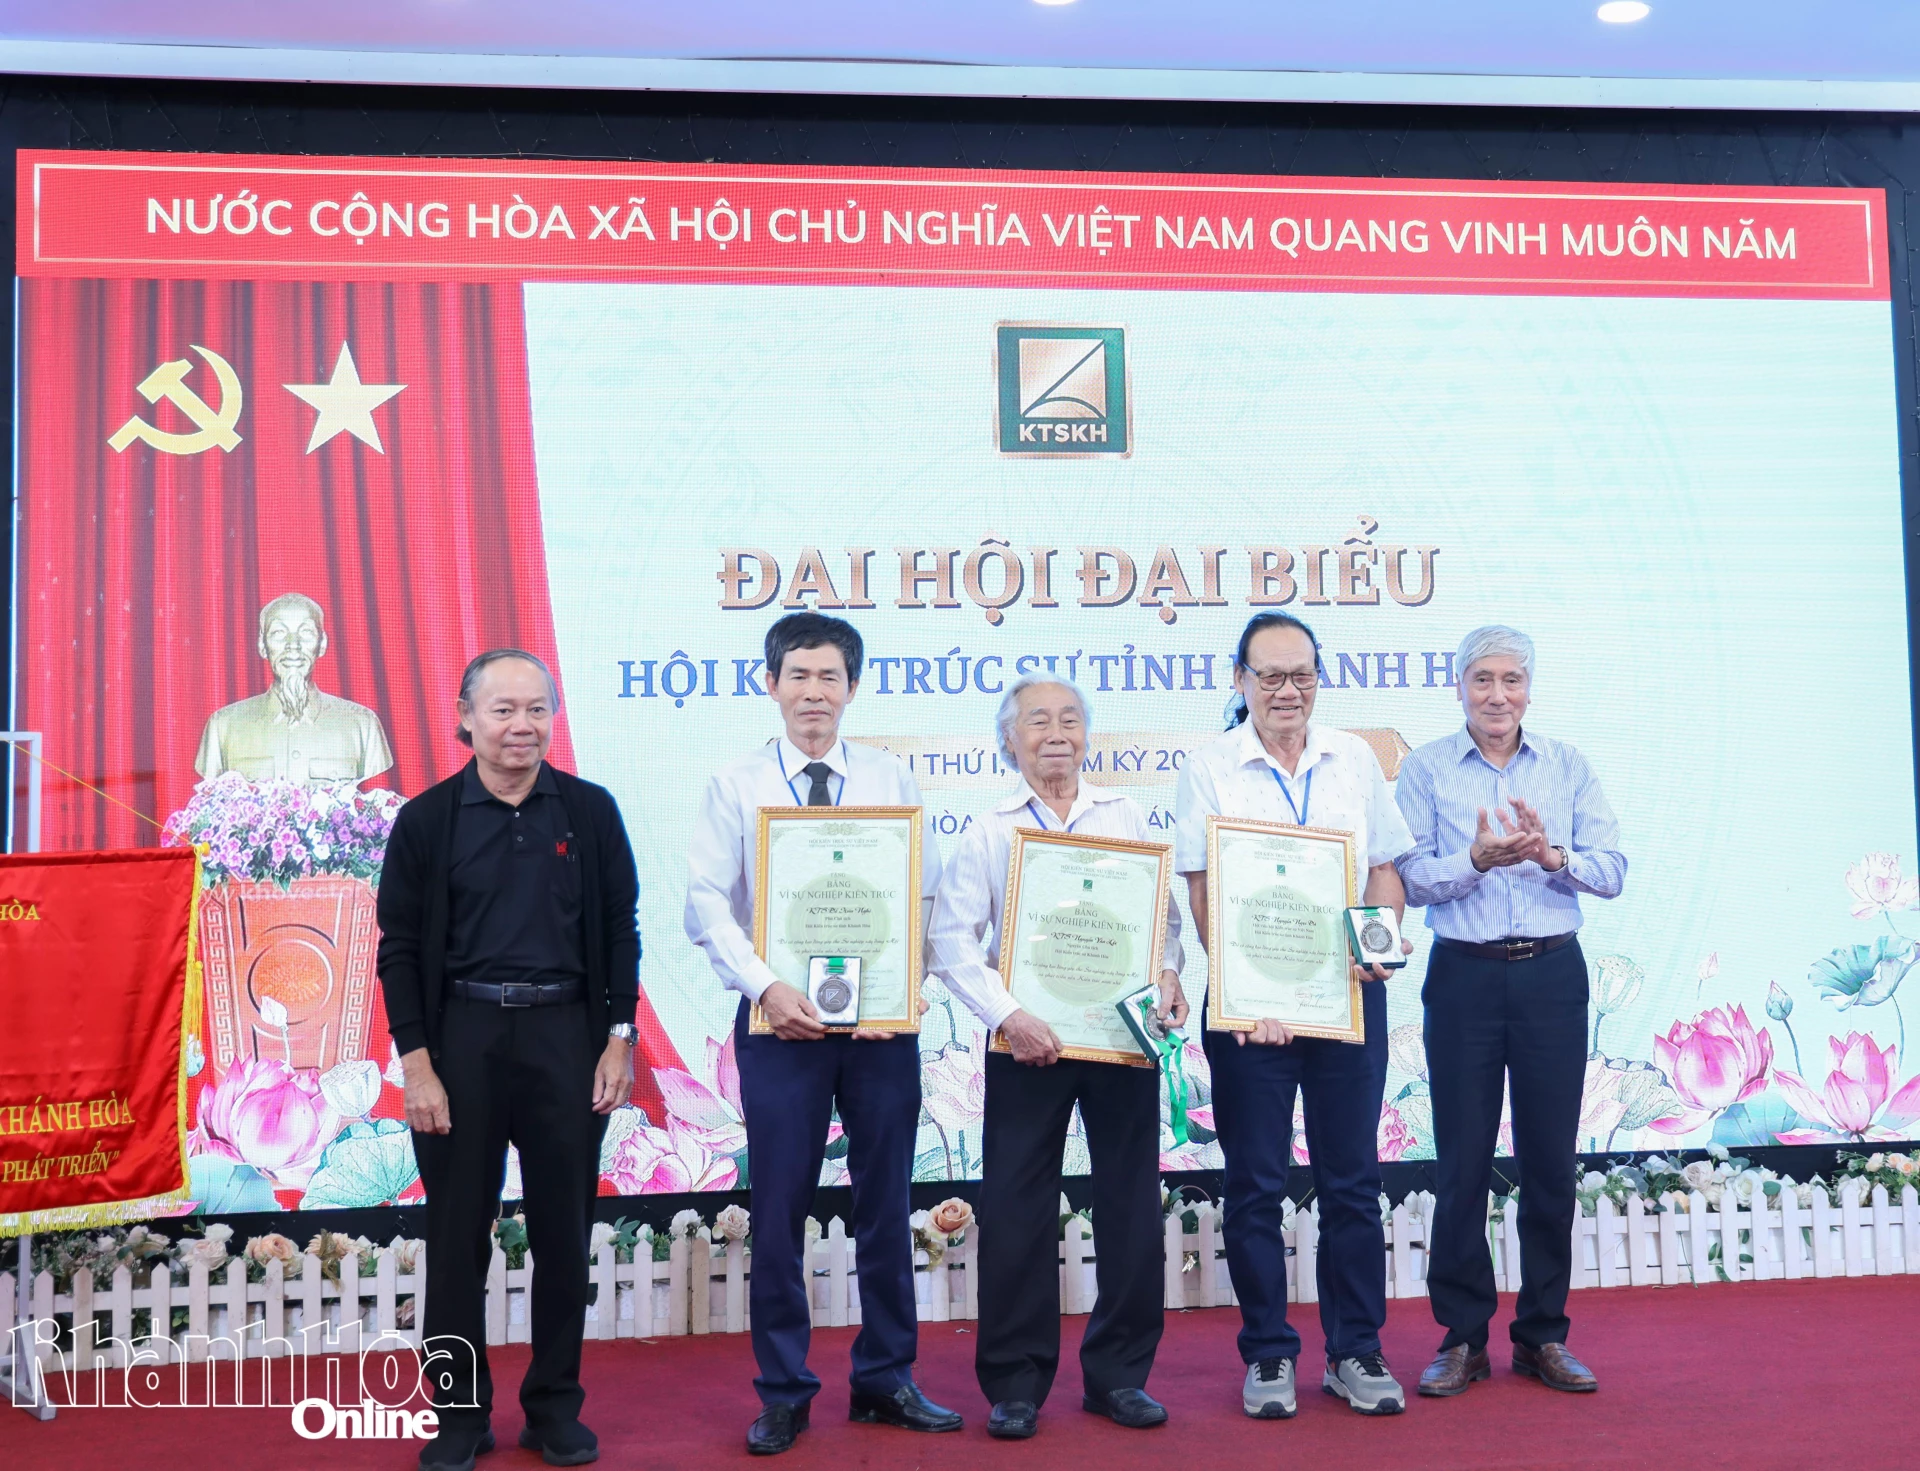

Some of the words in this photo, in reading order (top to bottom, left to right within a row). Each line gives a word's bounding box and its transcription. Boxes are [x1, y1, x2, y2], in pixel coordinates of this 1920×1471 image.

[147, 190, 293, 236] NƯỚC
[308, 194, 451, 246] CỘNG
[467, 195, 576, 241] HÒA
[587, 198, 656, 242] XÃ
[669, 199, 753, 251] HỘI
[769, 198, 867, 245] CHỦ
[882, 205, 1031, 249] NGHĨA
[1041, 203, 1143, 256] VIỆT
[1155, 214, 1255, 251] NAM
[1269, 218, 1430, 259] QUANG
[1441, 220, 1546, 256] VINH
[1561, 214, 1689, 259] MUÔN
[1701, 216, 1797, 260] NĂM
[1018, 423, 1108, 443] KTSKH
[894, 530, 1060, 627] HỘI
[1075, 544, 1230, 626] ĐẠI
[1243, 514, 1441, 608] BIỂU
[617, 649, 718, 709] HỘI
[868, 646, 1004, 695] TRÚC
[1088, 643, 1217, 692] TỈNH
[922, 747, 985, 776] THỨ
[1112, 744, 1148, 772] KỲ
[89, 1090, 136, 1128] HÒA
[2, 1152, 55, 1184] PHÁT
